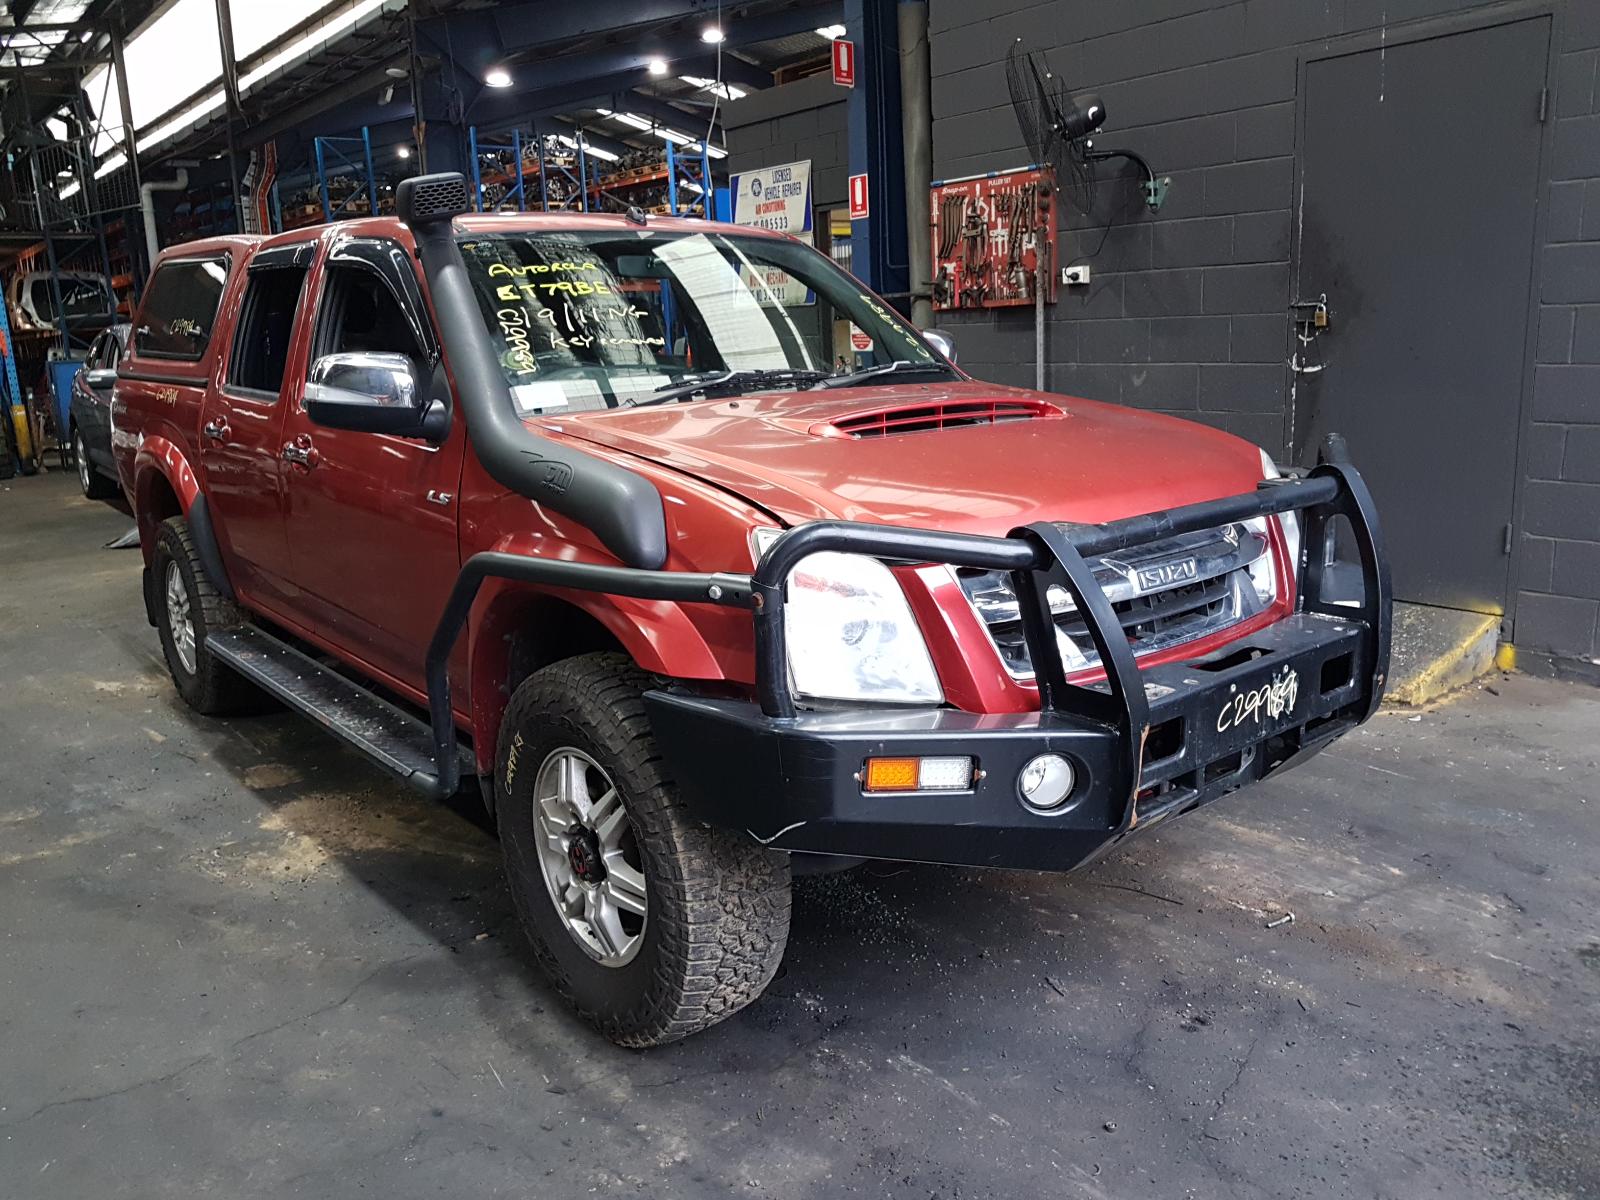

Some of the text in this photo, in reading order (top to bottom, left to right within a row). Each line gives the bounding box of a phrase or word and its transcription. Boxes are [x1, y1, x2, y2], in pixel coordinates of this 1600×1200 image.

[764, 181, 802, 200] VEHICLE REPAIRER
[988, 178, 1003, 187] PULLER
[762, 199, 786, 214] CONDITIONING
[426, 489, 453, 505] LS
[1140, 559, 1196, 589] ISUZU
